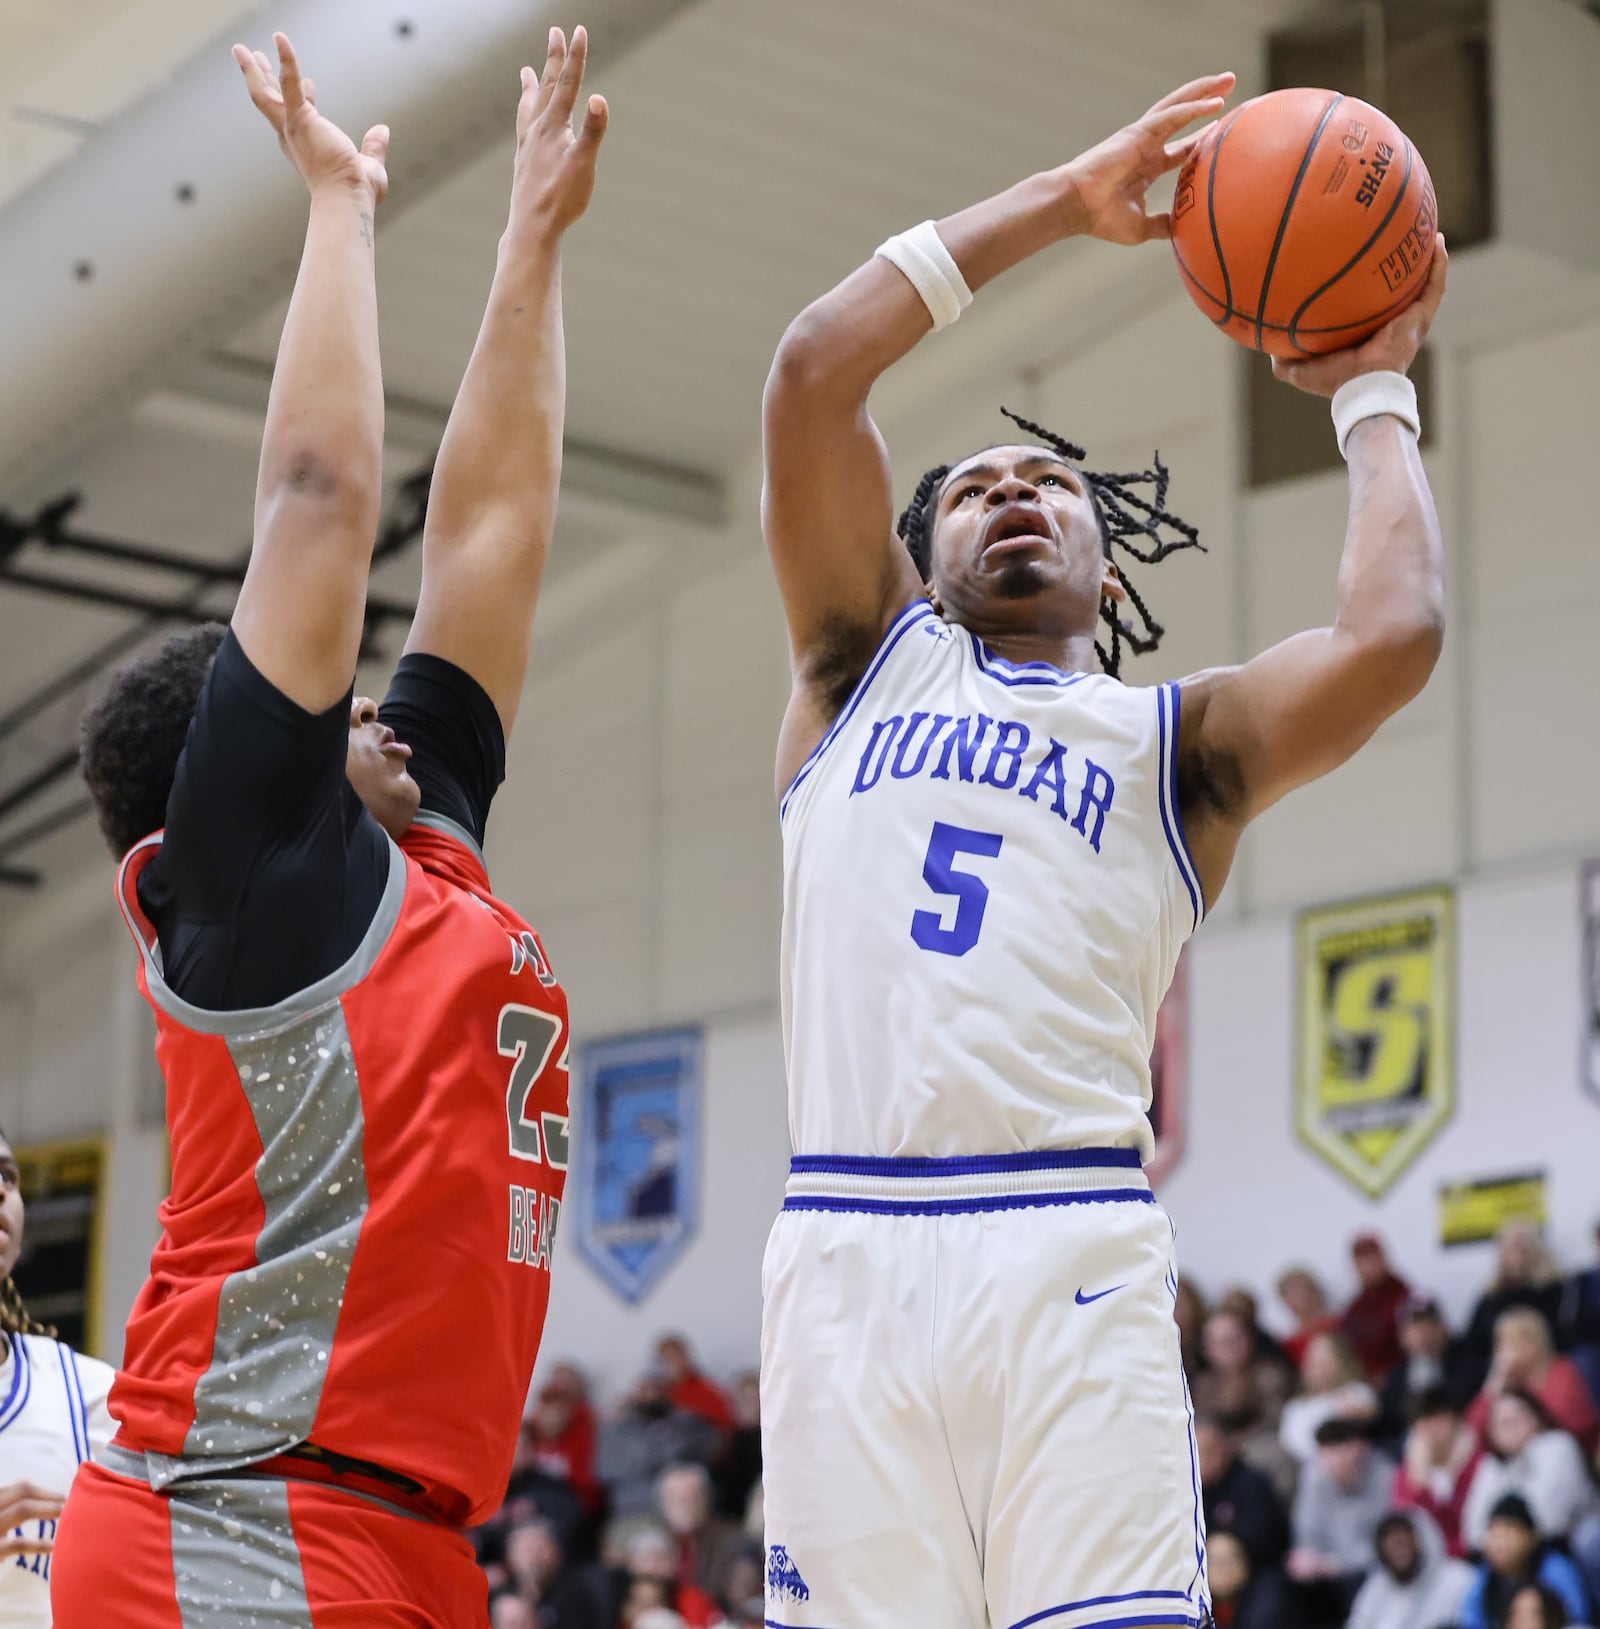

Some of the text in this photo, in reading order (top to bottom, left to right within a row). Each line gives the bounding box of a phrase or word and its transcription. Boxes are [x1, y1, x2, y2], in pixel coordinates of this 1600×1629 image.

[1355, 148, 1391, 209] NFHS
[849, 712, 1115, 855] DUNBAR
[911, 821, 1003, 957] 5
